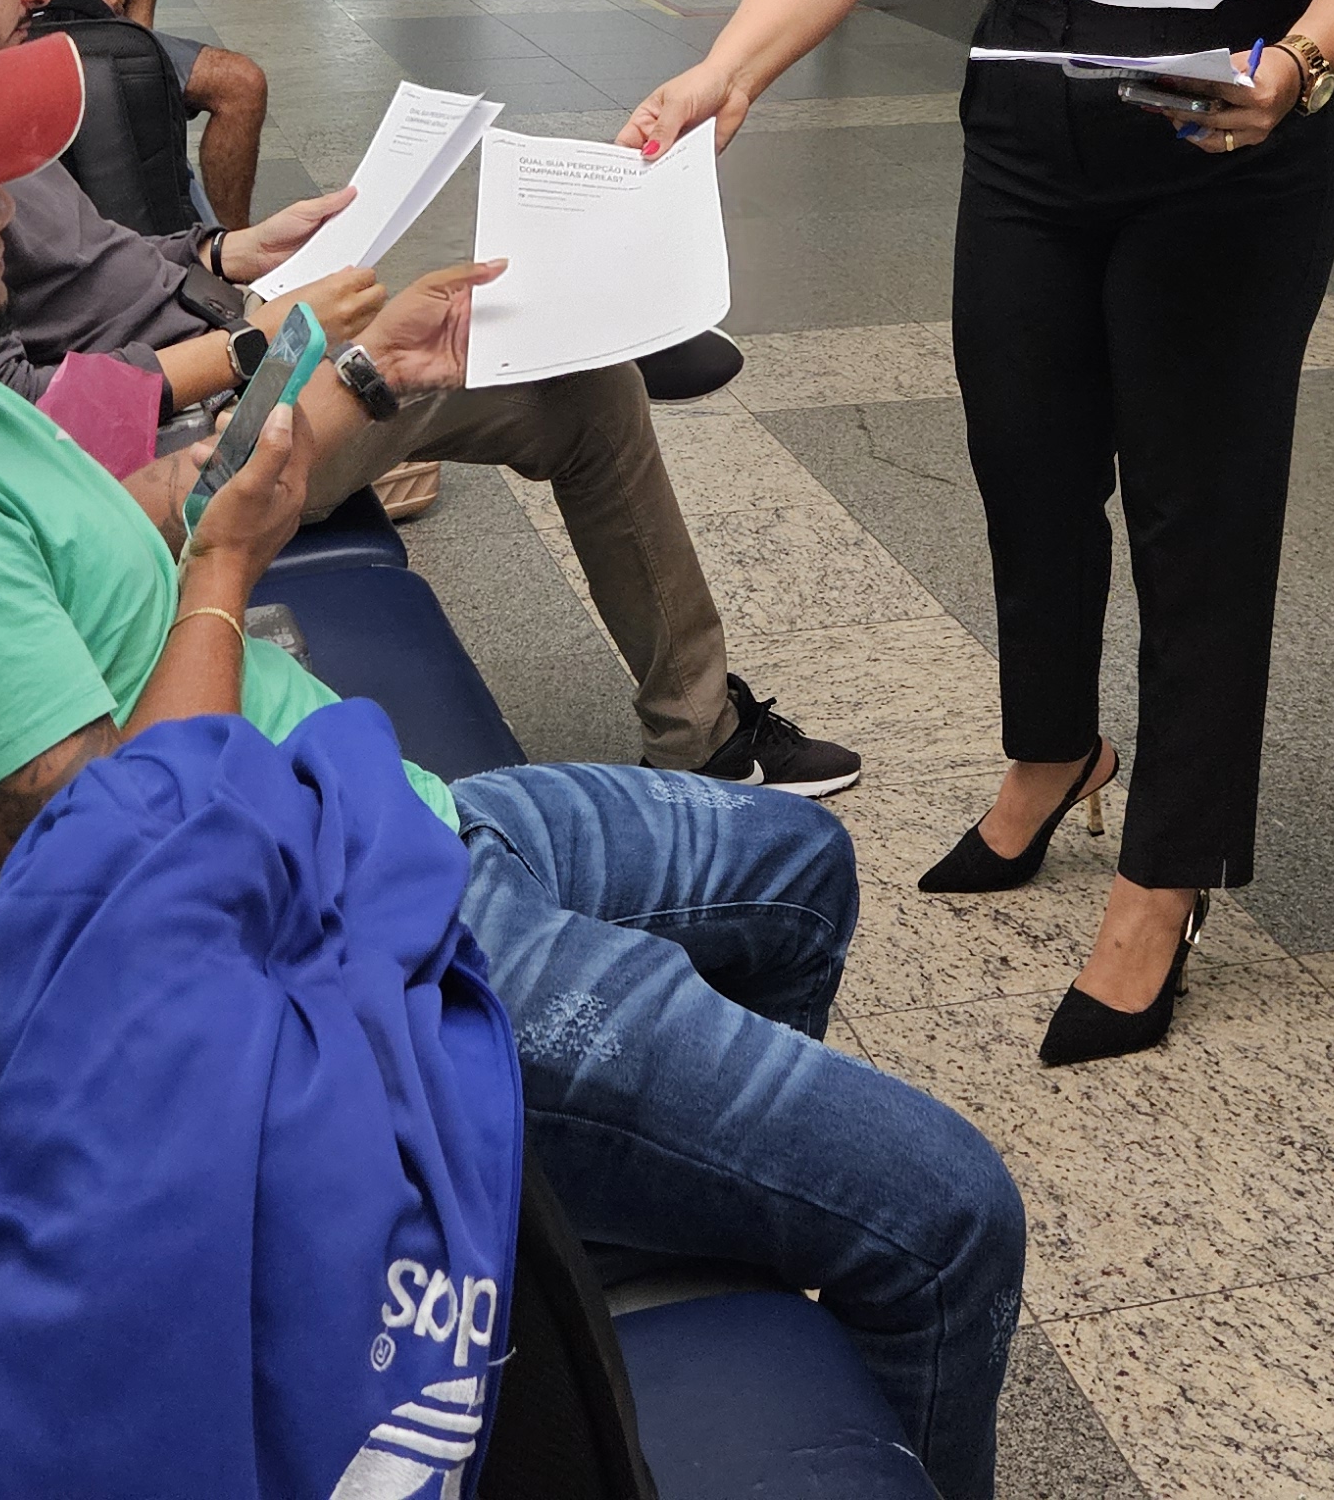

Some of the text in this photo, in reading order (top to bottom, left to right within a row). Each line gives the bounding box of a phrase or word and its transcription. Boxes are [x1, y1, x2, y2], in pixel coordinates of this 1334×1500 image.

[519, 156, 637, 176] QUAL SUA PERCEPÇÃO EM
[519, 166, 624, 183] COMPANHIAS AÉREAS?
